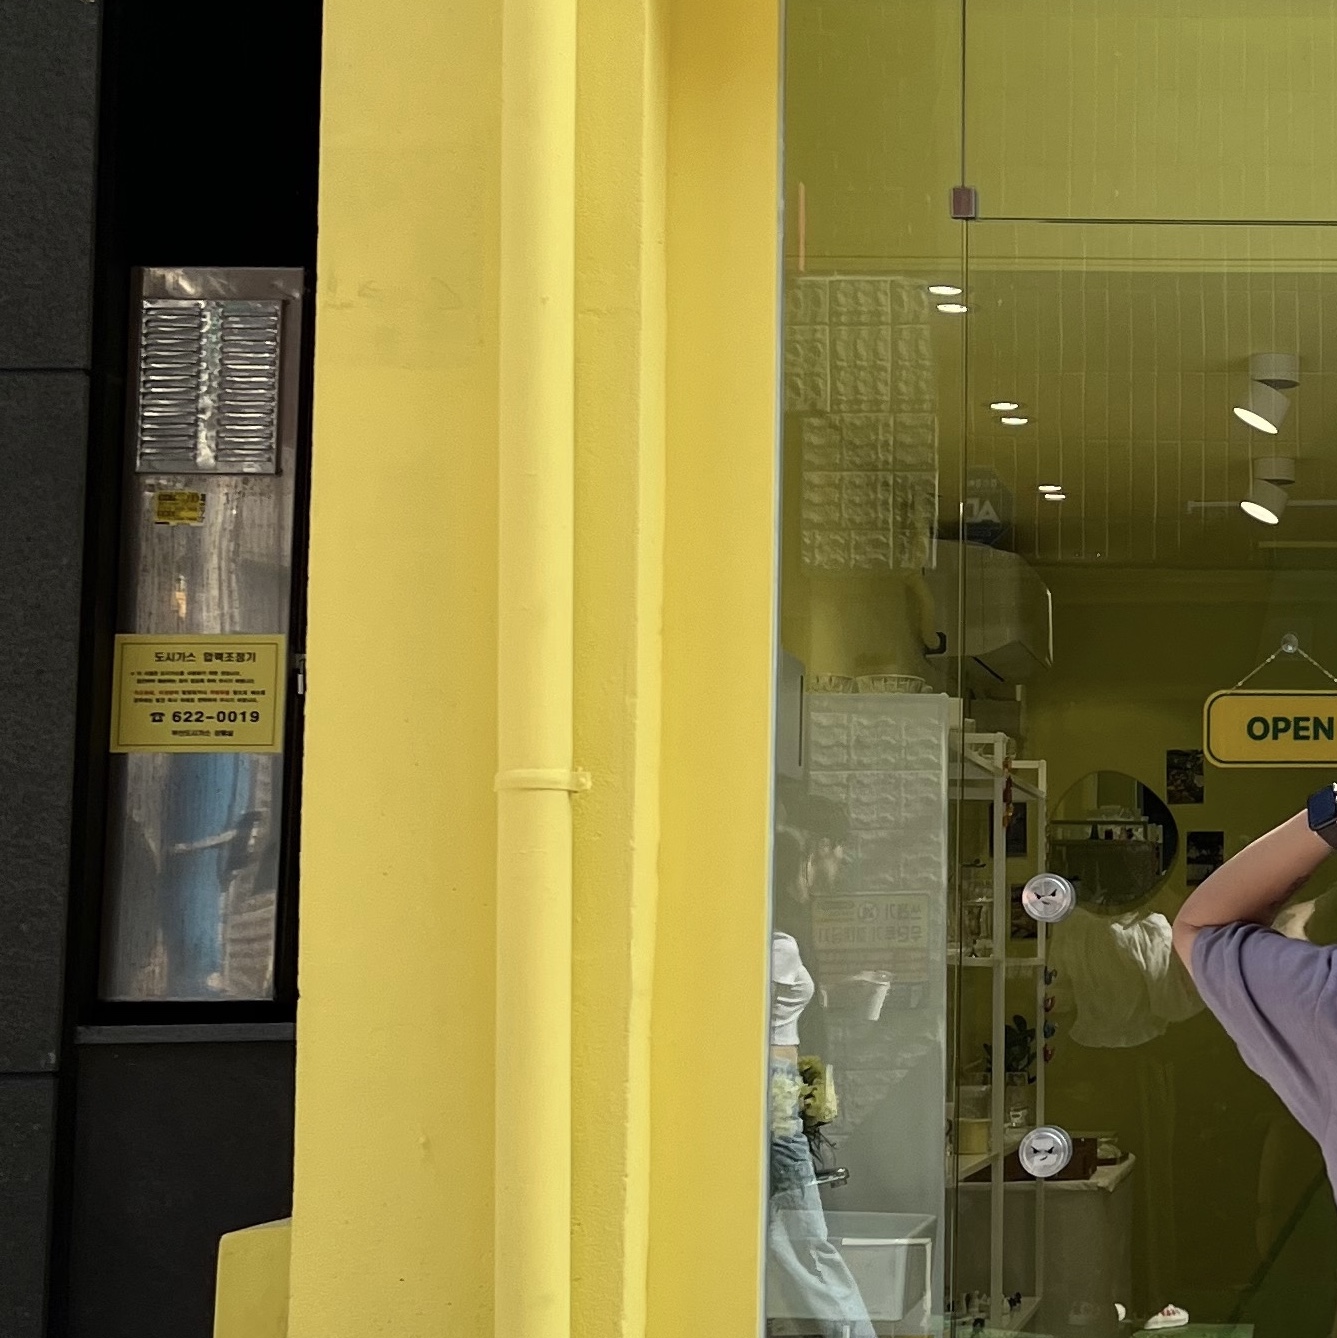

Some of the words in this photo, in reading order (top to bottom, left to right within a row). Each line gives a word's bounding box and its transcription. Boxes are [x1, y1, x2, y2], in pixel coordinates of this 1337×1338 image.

[154, 652, 196, 662] 도시가스
[171, 711, 260, 723] 622-0019
[1247, 716, 1334, 741] OPEN
